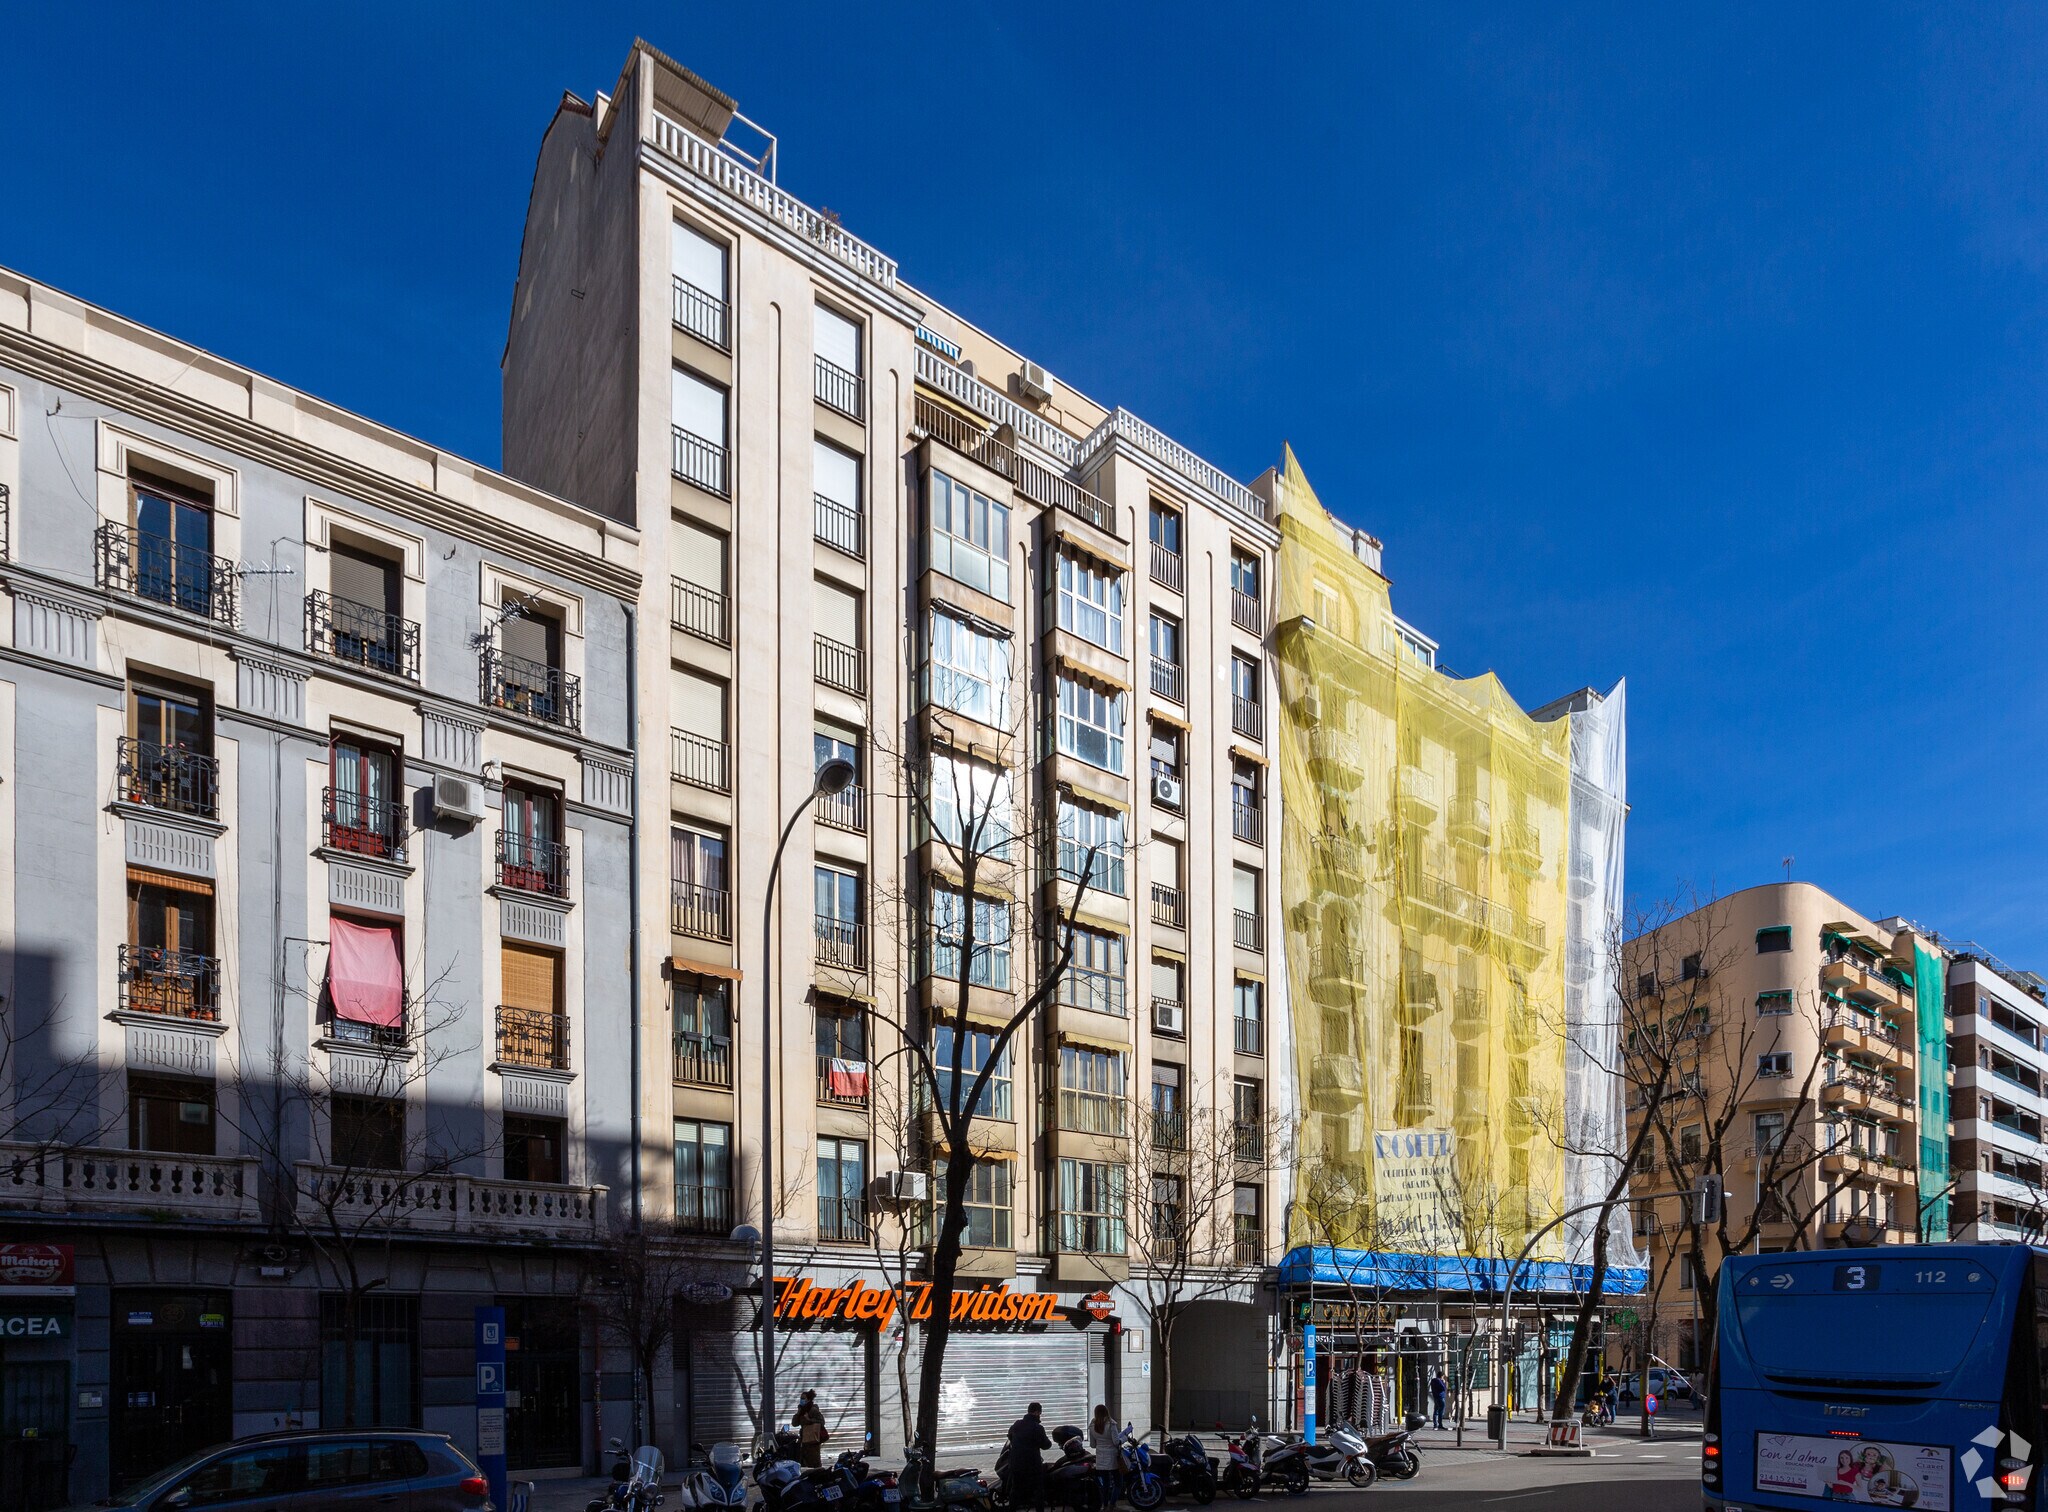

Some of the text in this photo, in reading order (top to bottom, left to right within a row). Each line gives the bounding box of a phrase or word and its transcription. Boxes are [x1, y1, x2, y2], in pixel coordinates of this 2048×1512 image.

[1375, 1133, 1453, 1159] ROSFER
[1, 1255, 60, 1267] Mahou
[1846, 1266, 1866, 1289] 3
[1915, 1271, 1946, 1283] 112
[1307, 1360, 1314, 1376] P
[480, 1365, 496, 1391] P
[1760, 1448, 1827, 1464] Con el alma
